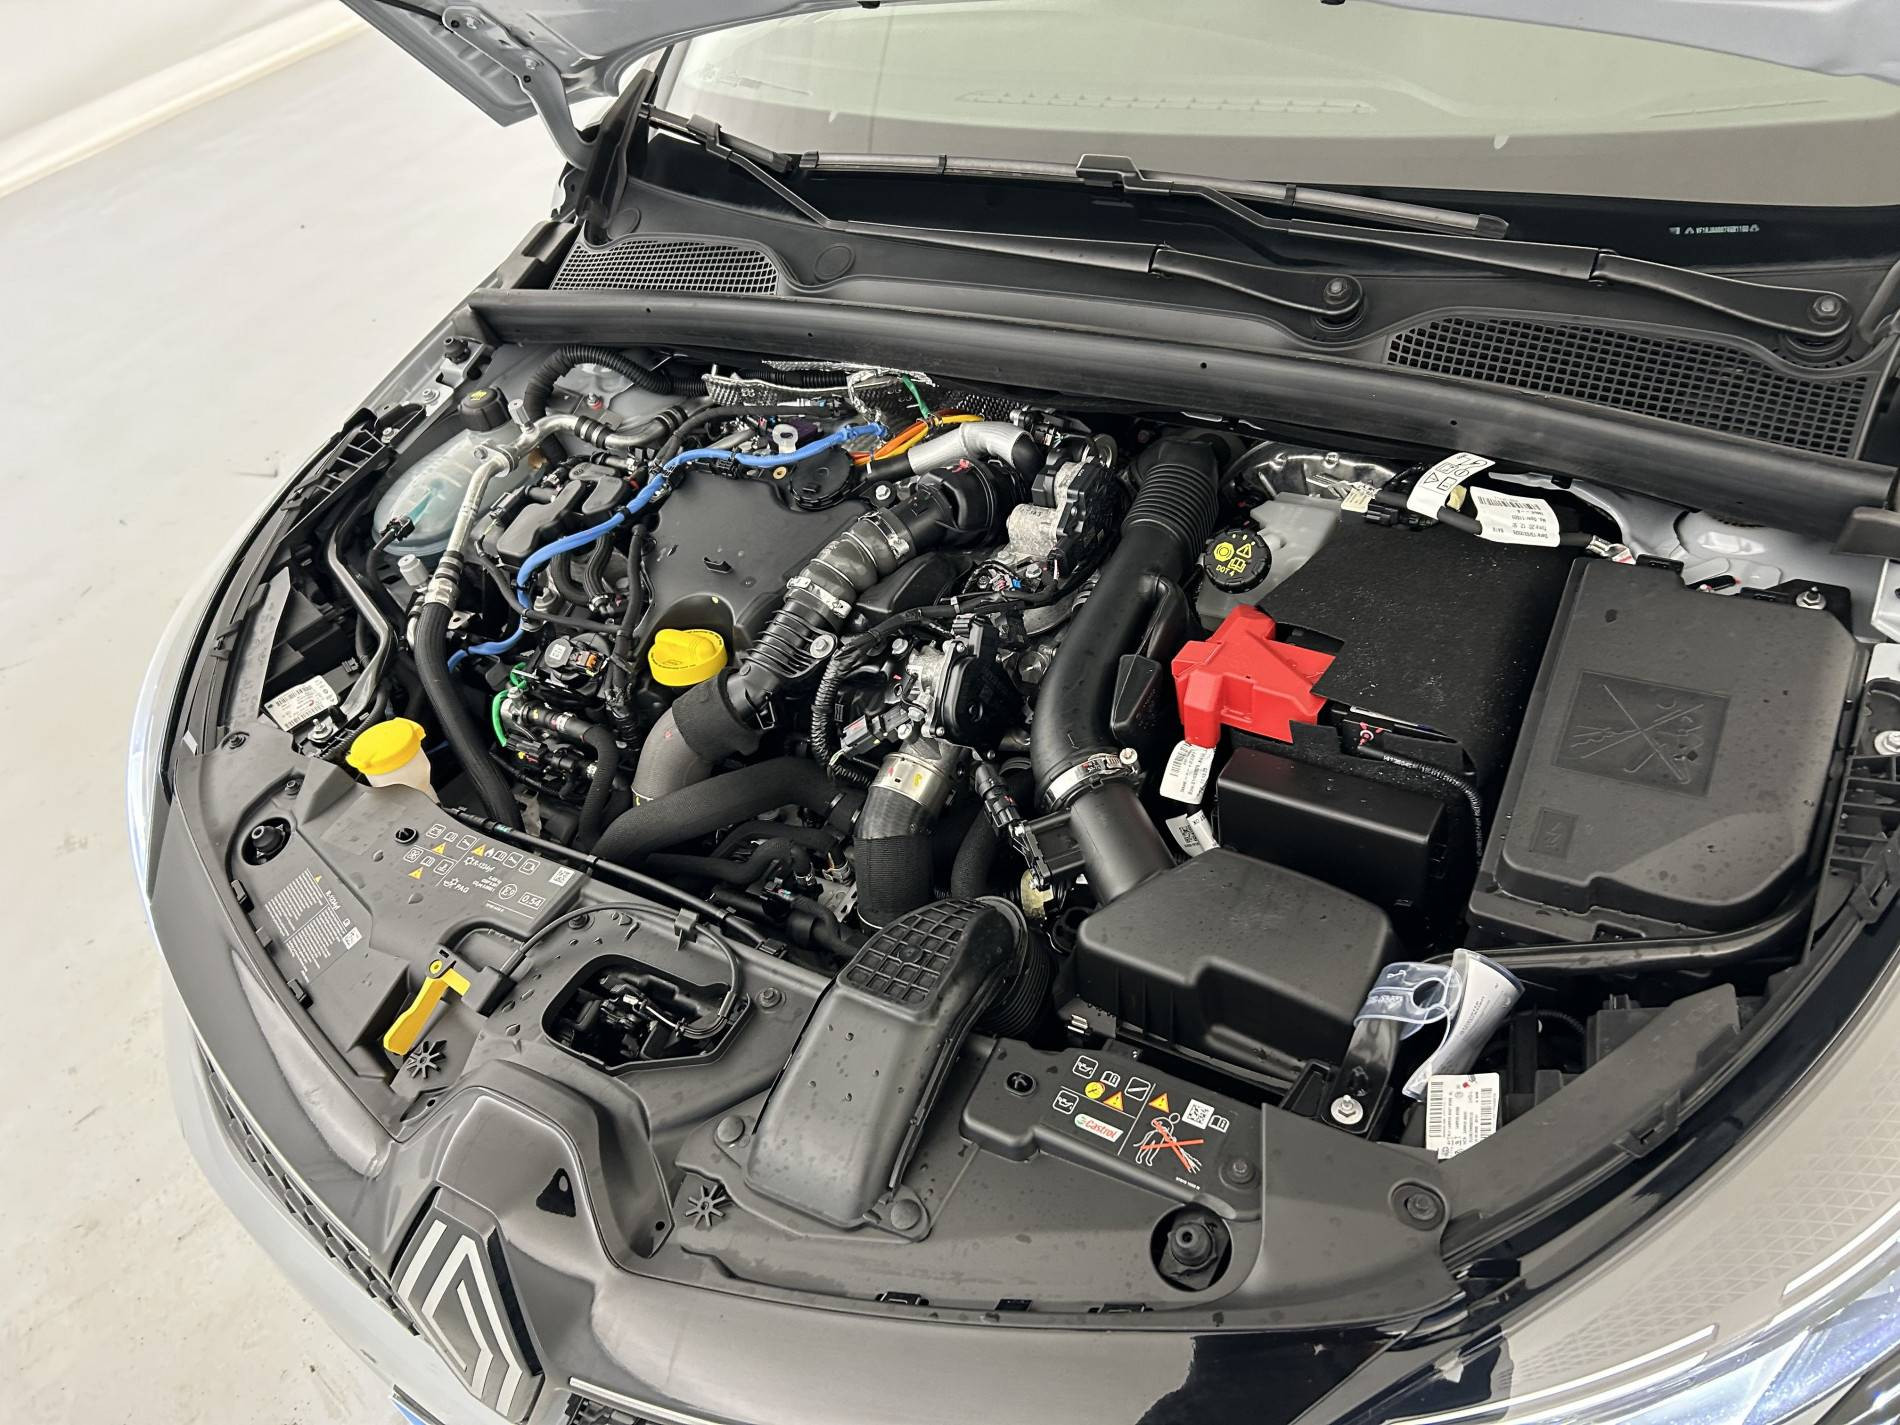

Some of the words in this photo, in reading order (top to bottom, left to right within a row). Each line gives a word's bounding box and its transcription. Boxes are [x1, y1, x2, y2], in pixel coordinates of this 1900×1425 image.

[1216, 564, 1230, 574] DOT
[455, 883, 470, 893] PAG
[1085, 1119, 1117, 1138] Castrol
